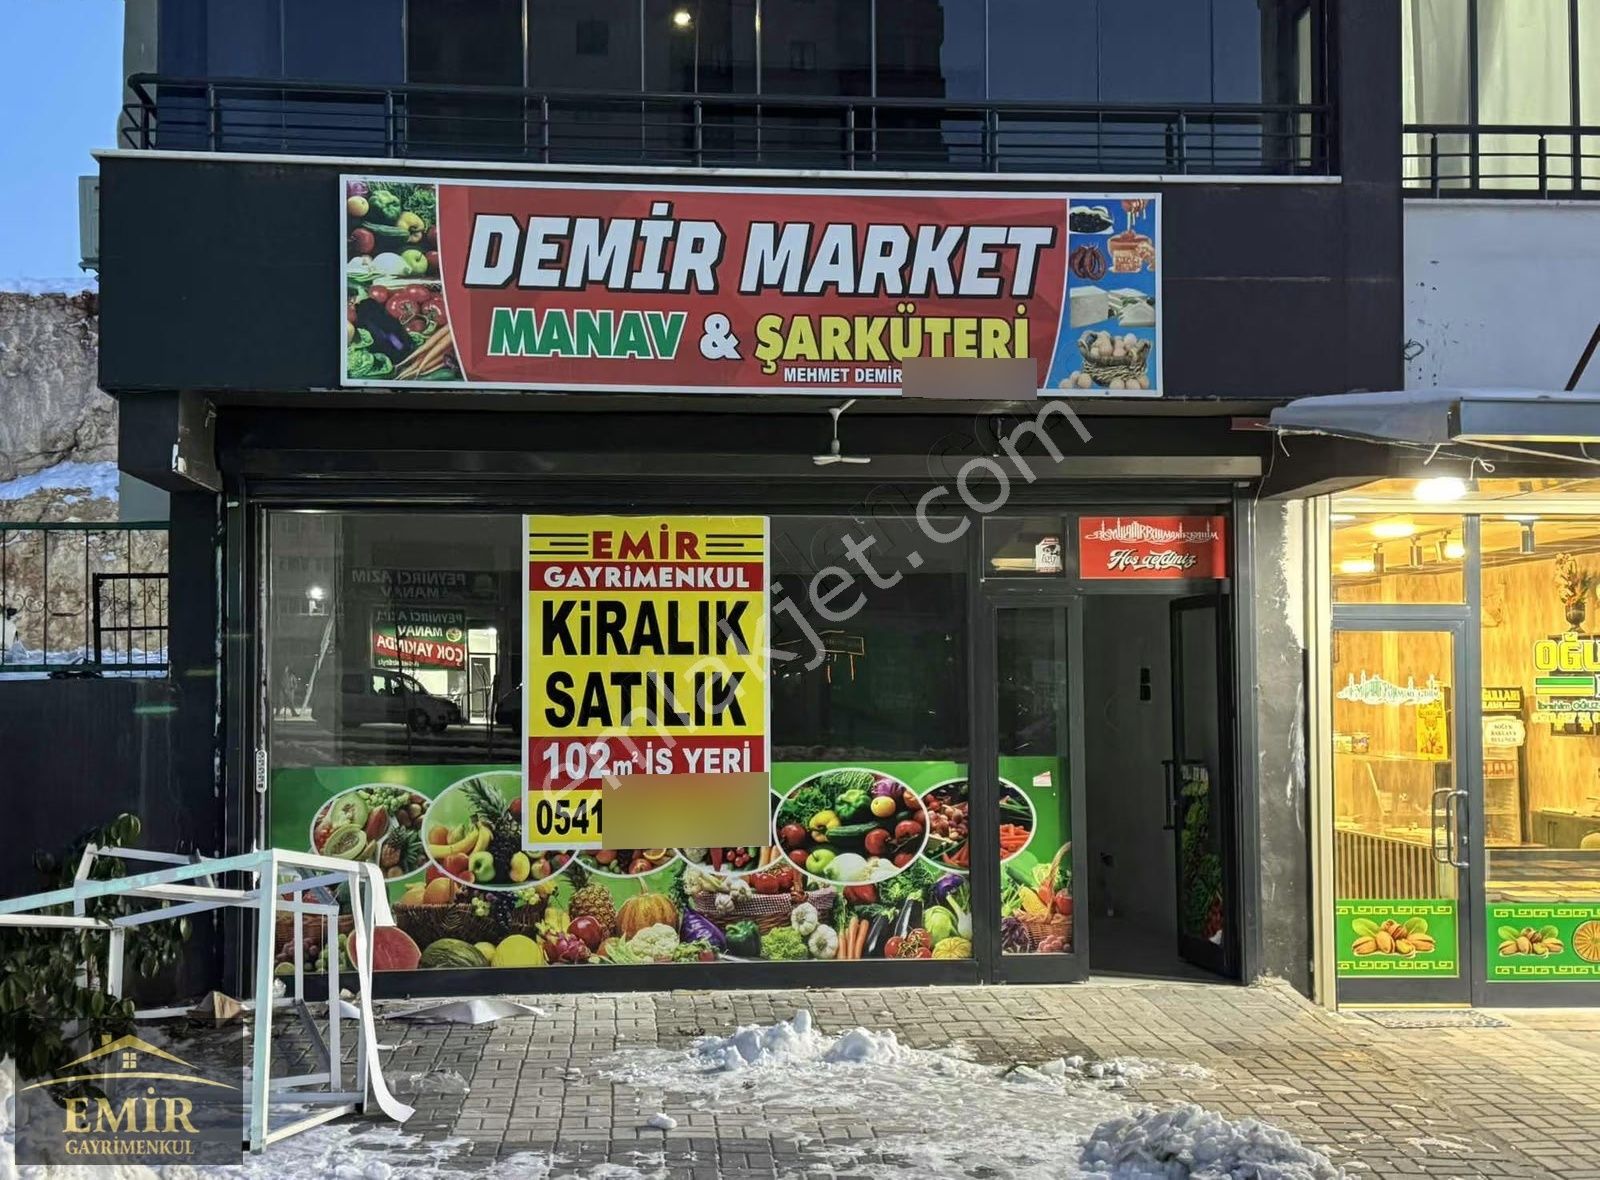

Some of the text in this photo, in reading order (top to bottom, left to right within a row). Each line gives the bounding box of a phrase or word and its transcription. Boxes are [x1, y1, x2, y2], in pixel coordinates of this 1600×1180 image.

[463, 201, 1056, 297] DEMİR MARKET
[487, 303, 1029, 374] MANAV & ŞARKÜTERİ
[783, 365, 903, 383] MEHMET DEMİR
[592, 523, 701, 560] EMİR
[544, 671, 747, 728] SATILIK
[682, 741, 750, 774] YERİ
